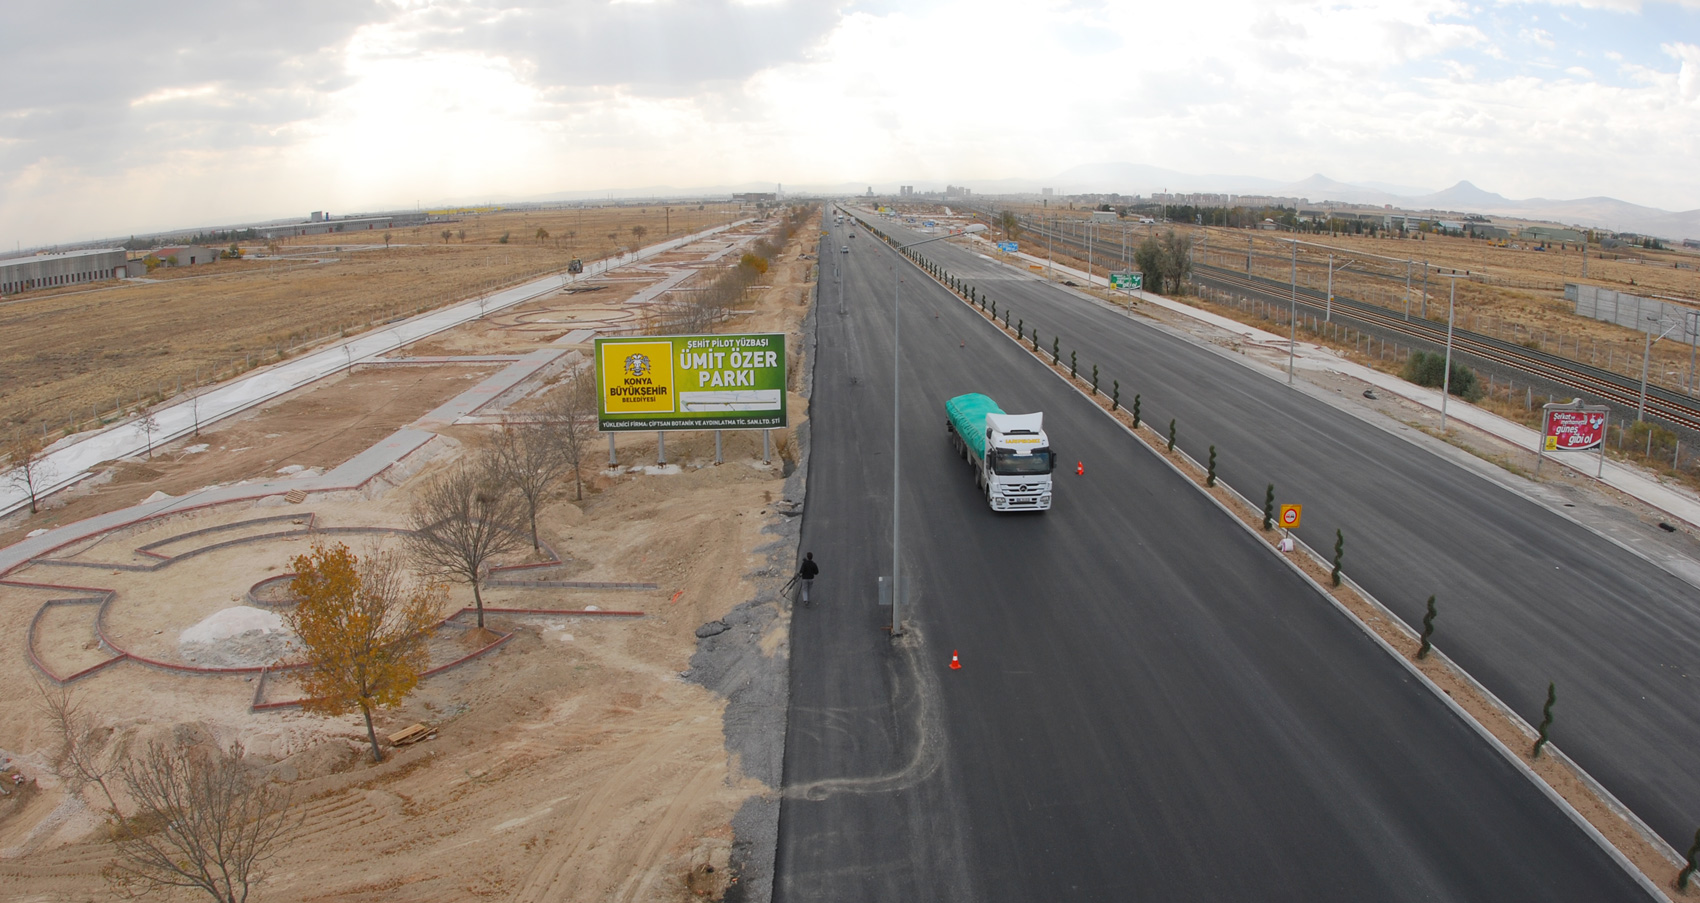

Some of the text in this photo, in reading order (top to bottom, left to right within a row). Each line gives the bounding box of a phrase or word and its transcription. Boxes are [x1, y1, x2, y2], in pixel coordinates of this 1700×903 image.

[687, 338, 768, 348] ŞEHİT PİLOT YÜZBAŞI
[680, 348, 778, 370] ÜMİT ÖZER
[624, 378, 652, 386] KONYA
[699, 370, 754, 387] PARKI
[610, 385, 667, 396] BÜYÜKŞEHİR
[1556, 426, 1578, 434] güneş
[1568, 434, 1593, 446] gibi ol
